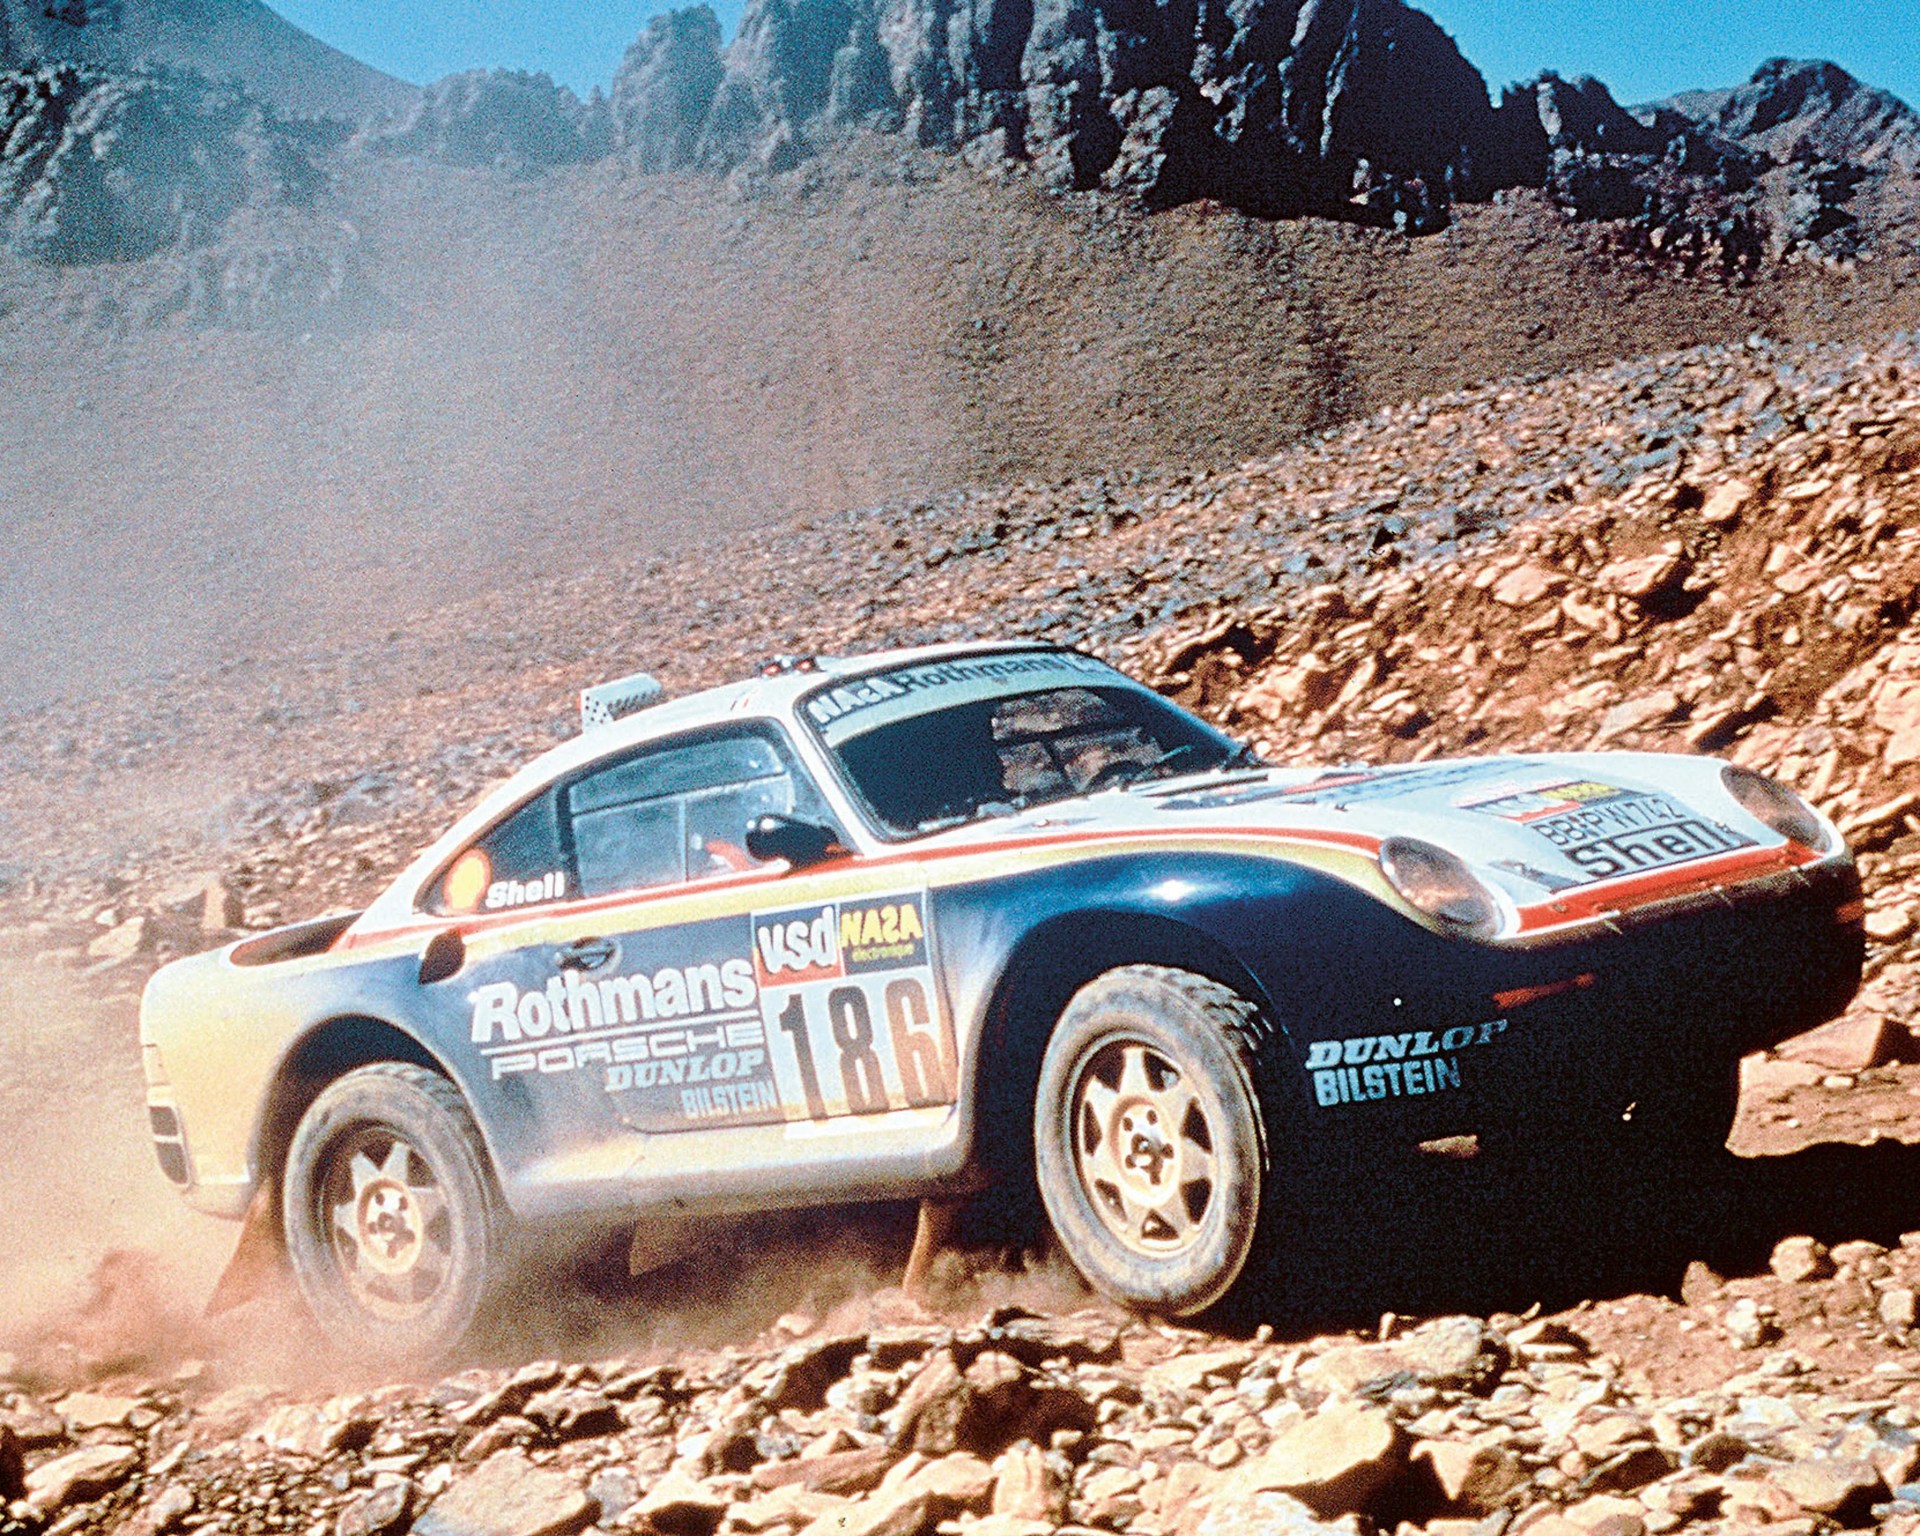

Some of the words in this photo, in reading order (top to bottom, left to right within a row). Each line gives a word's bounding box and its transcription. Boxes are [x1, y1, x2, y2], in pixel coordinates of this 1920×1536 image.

[884, 658, 1067, 690] Rothmans
[1558, 819, 1732, 878] Shell
[484, 872, 566, 908] Shell
[466, 957, 758, 1043] Rothmans
[491, 1019, 765, 1080] PORSCHE
[778, 976, 945, 1122] 186
[1304, 1018, 1509, 1070] DUNLOP
[604, 1048, 766, 1093] DUNLOP
[1313, 1056, 1463, 1107] BILSTEIN
[681, 1078, 779, 1119] BILSTEIN
